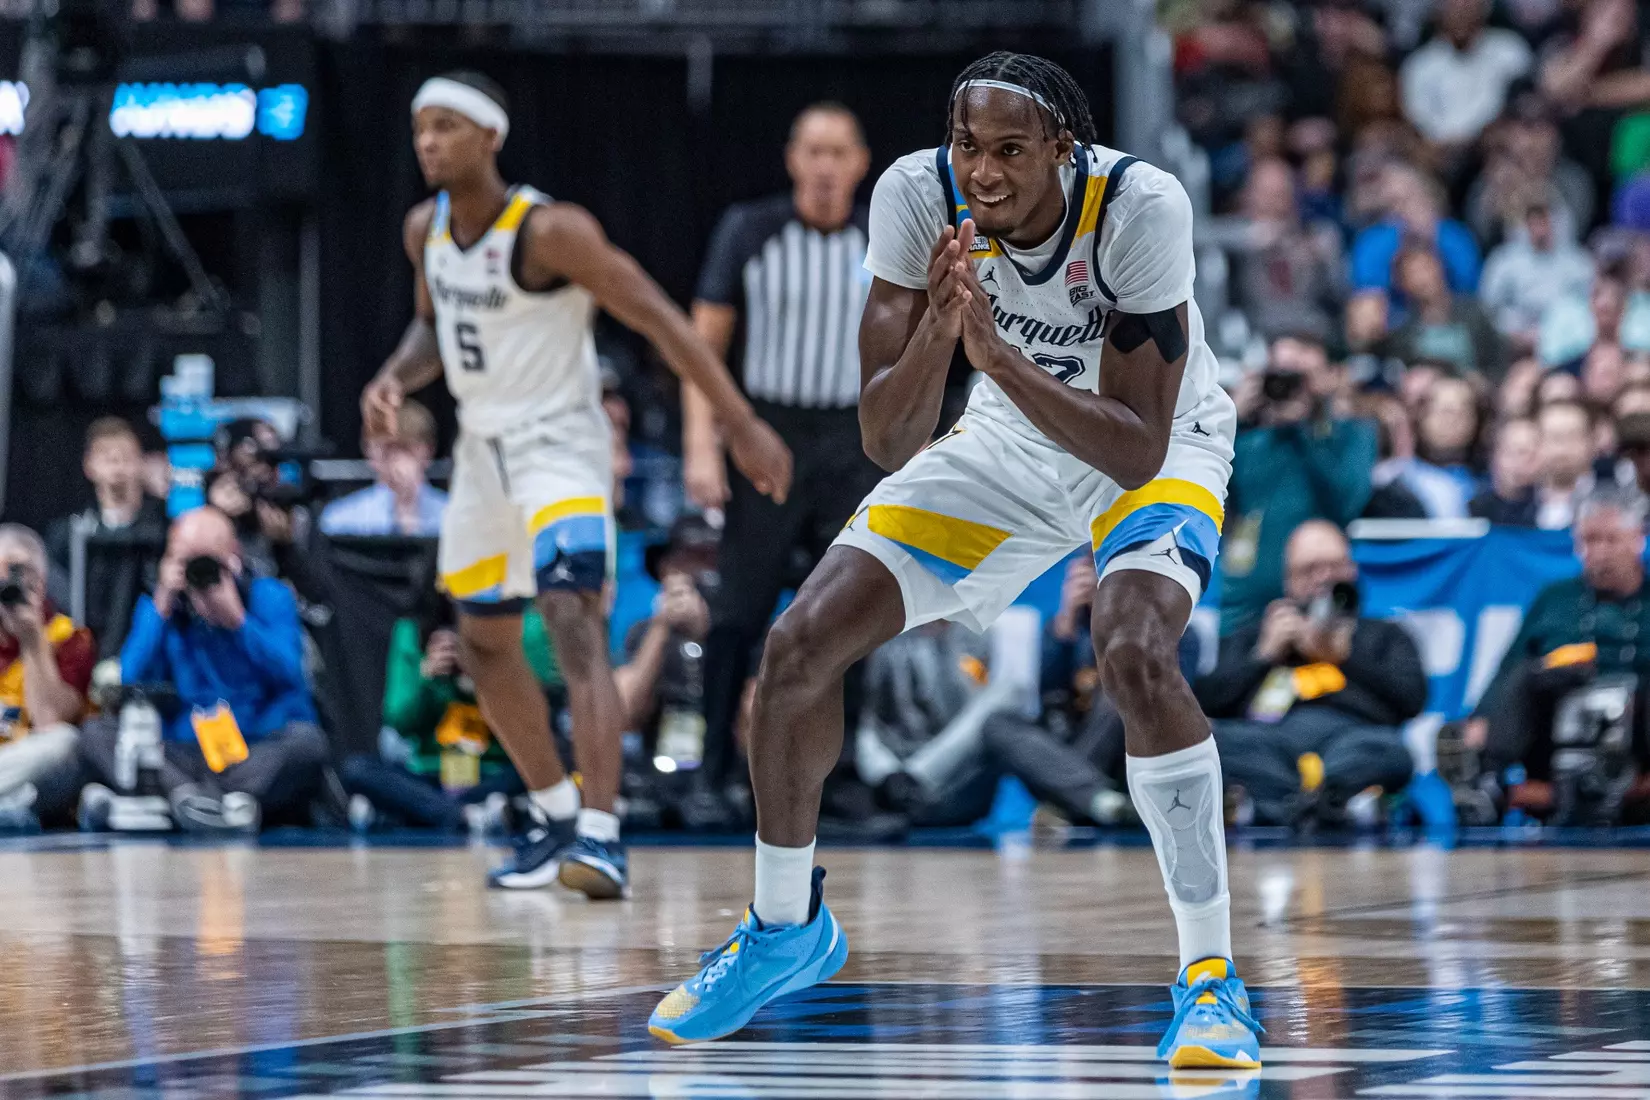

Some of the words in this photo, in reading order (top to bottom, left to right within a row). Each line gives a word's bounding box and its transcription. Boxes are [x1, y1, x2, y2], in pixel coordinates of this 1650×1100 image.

[1069, 285, 1088, 297] BIG
[1070, 290, 1095, 304] EAST
[456, 322, 485, 372] 5
